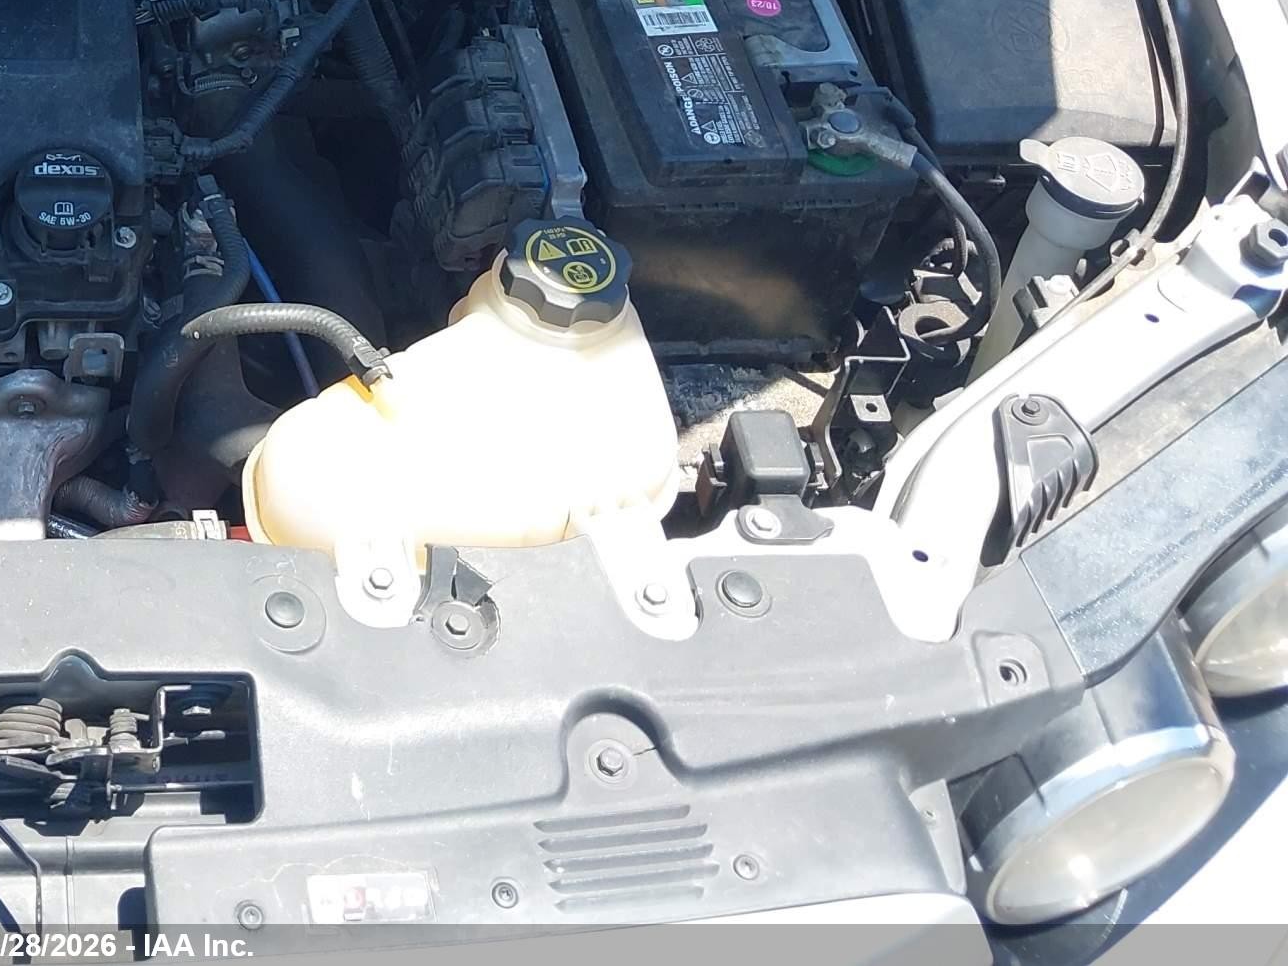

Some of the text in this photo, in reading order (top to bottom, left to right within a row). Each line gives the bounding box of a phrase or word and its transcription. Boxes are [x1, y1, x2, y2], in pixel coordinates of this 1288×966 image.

[750, 0, 778, 10] 10/23
[34, 162, 98, 175] dexos
[38, 211, 92, 226] SAE 5W-30
